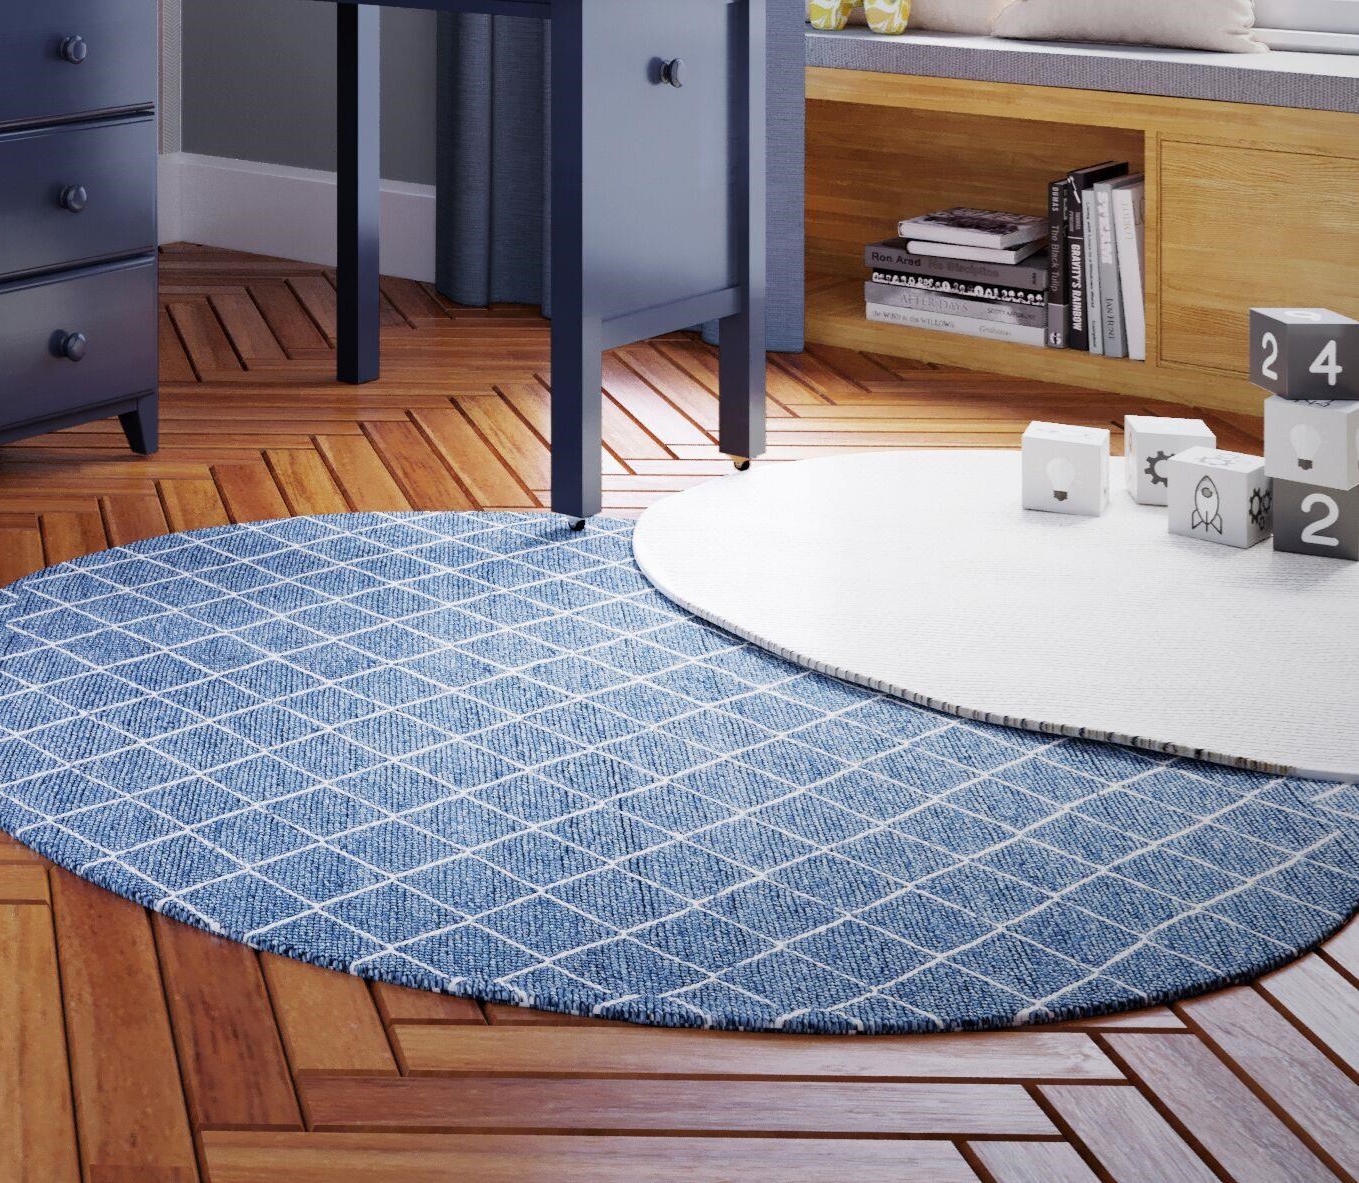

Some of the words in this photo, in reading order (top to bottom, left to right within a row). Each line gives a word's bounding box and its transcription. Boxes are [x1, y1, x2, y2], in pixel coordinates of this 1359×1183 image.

[1051, 225, 1060, 242] The
[871, 251, 893, 263] Ron
[896, 255, 922, 267] Arad
[1050, 243, 1060, 268] Black
[1070, 243, 1082, 289] GRAVITY'S
[1050, 271, 1061, 292] Tulip
[1071, 290, 1083, 332] RAINBOW
[1261, 331, 1278, 381] 2
[1308, 339, 1343, 386] 4
[1300, 492, 1340, 547] 2
